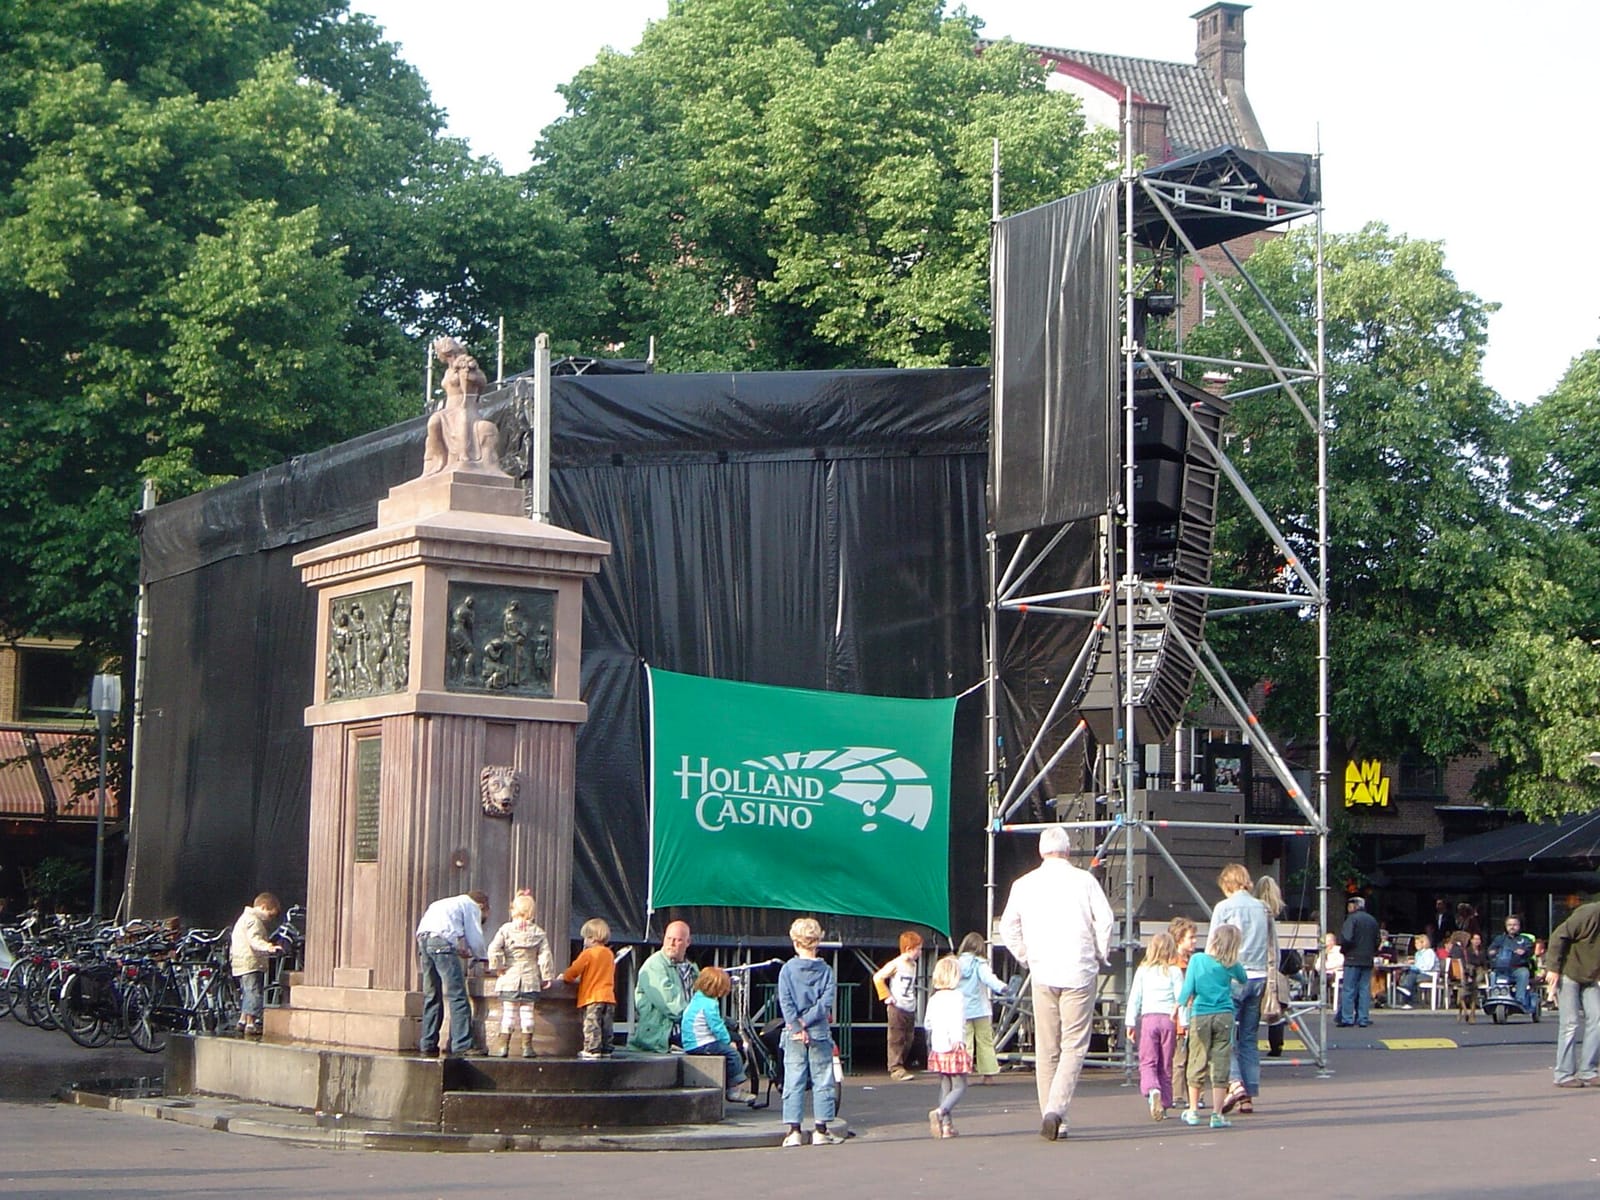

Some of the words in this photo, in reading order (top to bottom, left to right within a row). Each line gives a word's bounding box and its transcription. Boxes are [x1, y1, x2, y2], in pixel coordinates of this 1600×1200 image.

[673, 755, 824, 799] HOLLAND
[695, 791, 813, 832] CASINO
[900, 976, 913, 998] 7
